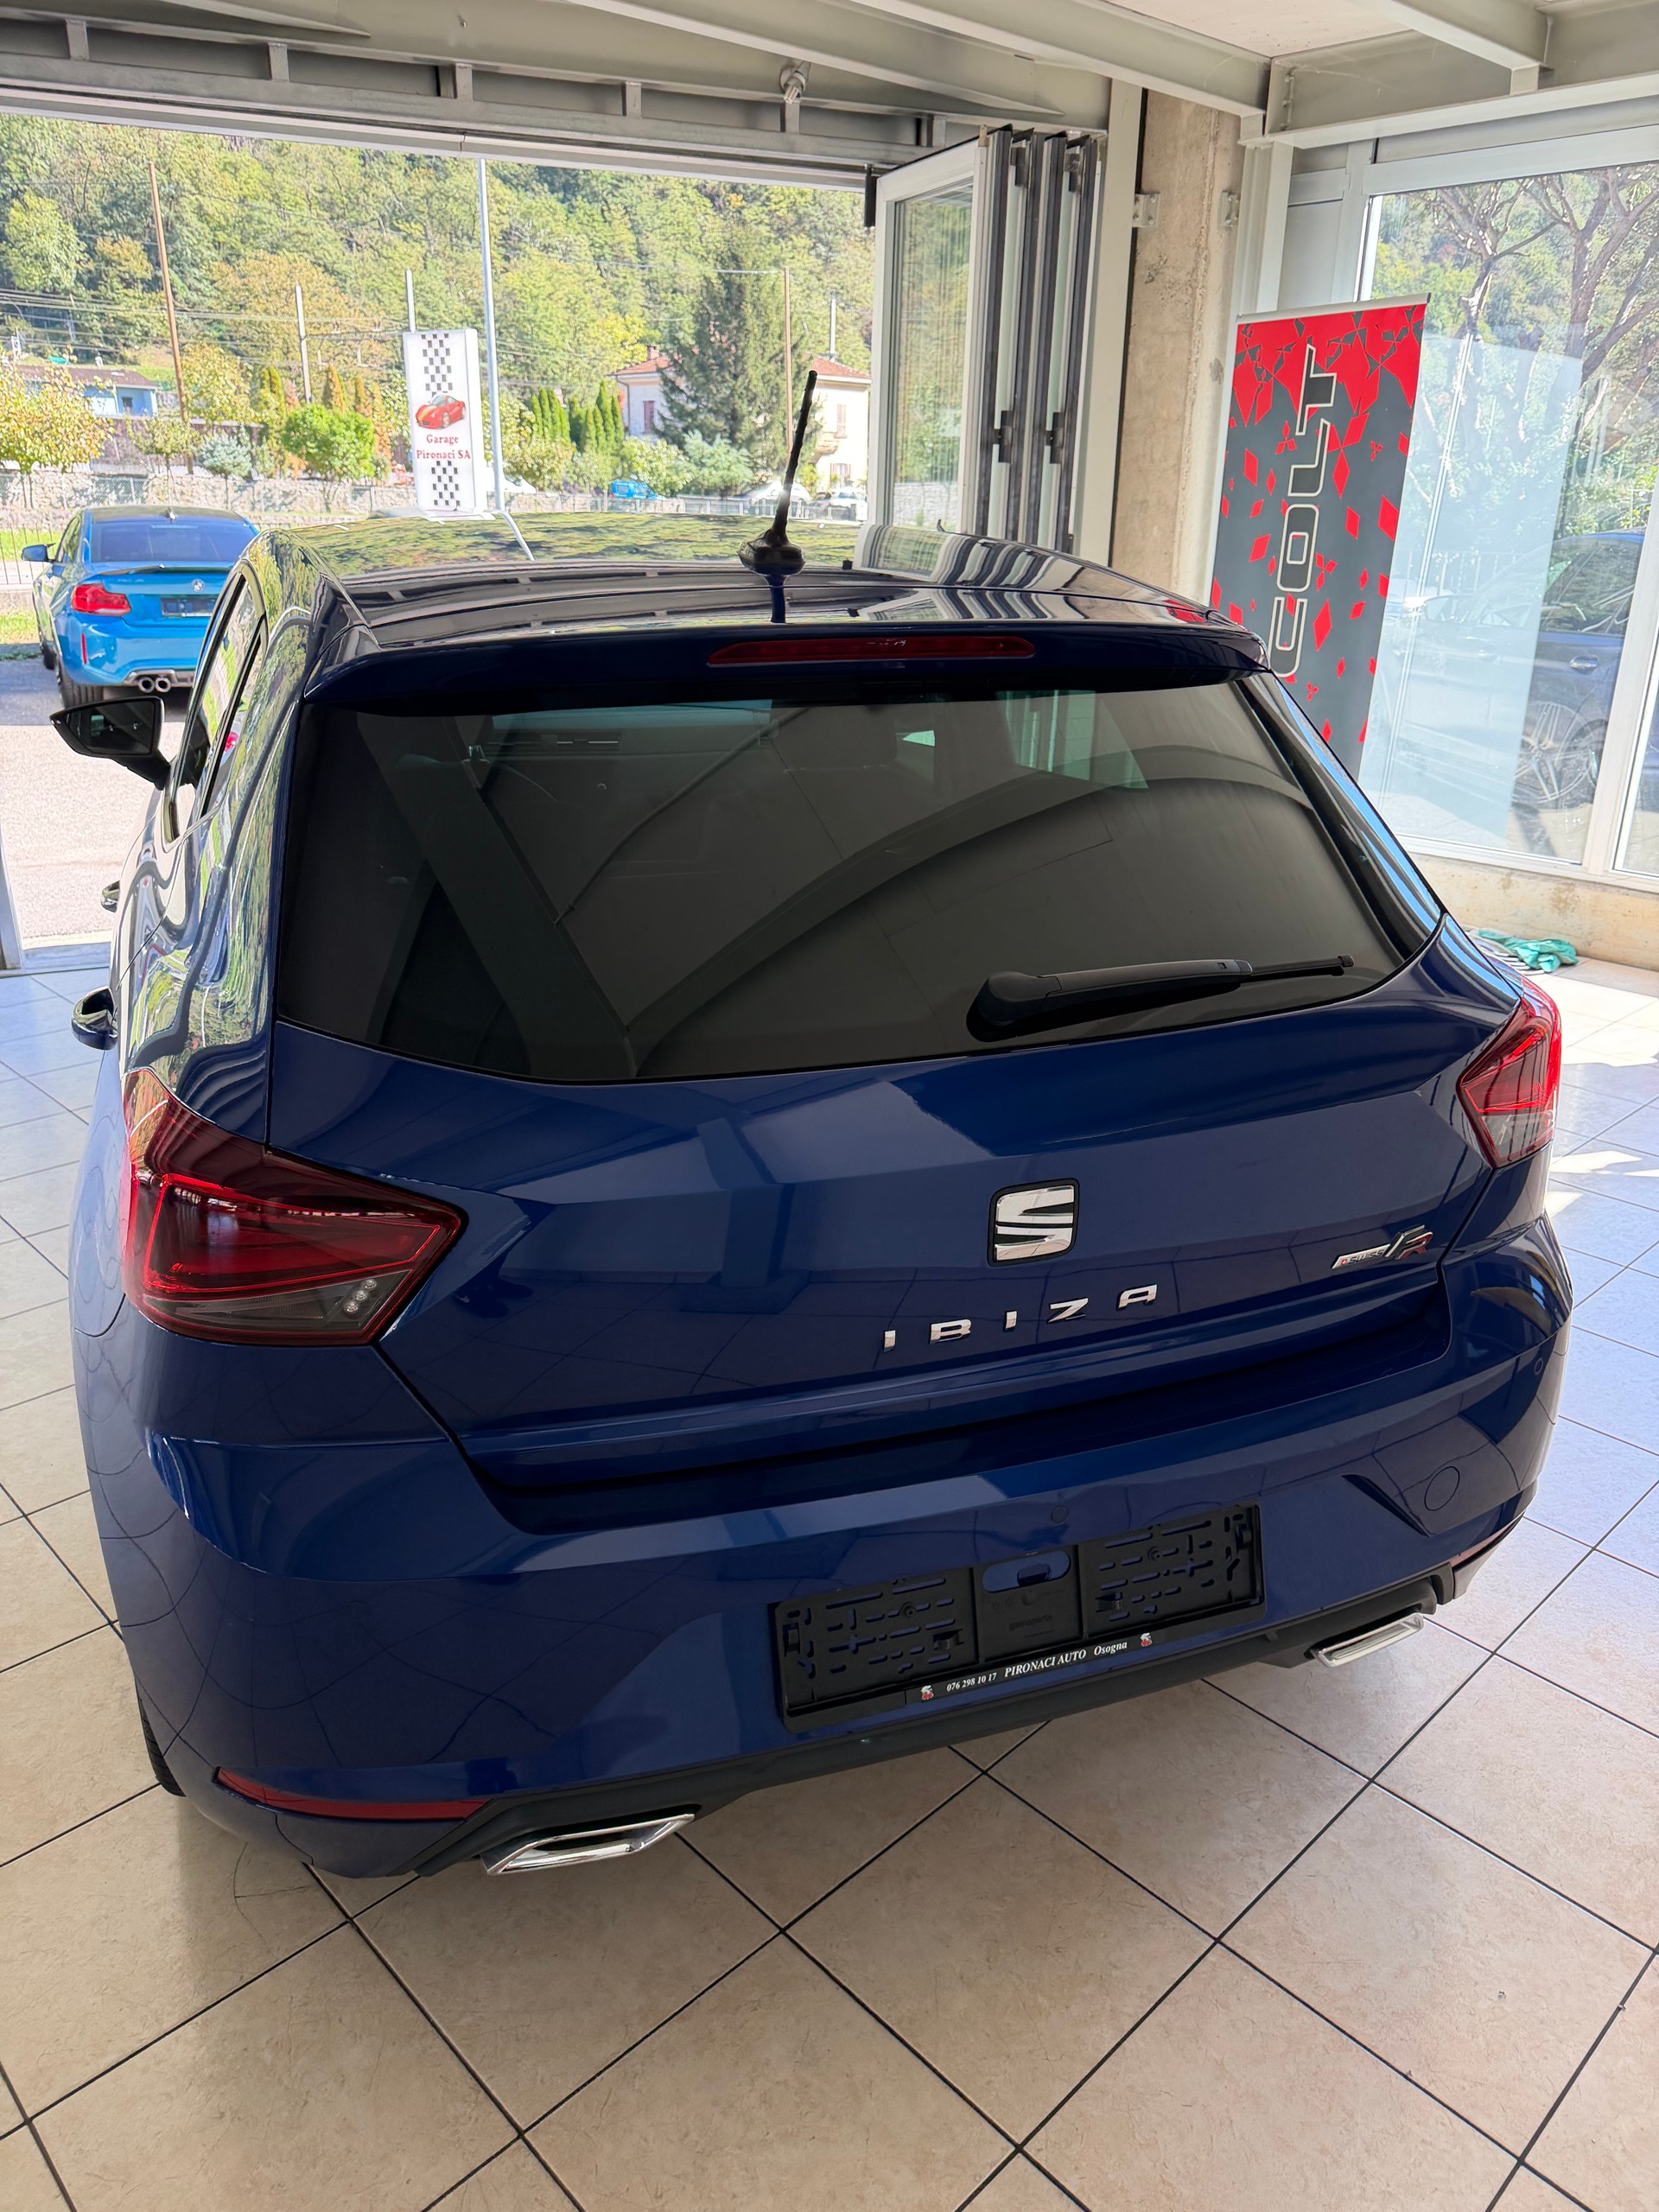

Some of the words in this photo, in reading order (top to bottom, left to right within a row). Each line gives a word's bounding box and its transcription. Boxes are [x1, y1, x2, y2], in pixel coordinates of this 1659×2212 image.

[416, 449, 455, 459] Pironaci
[458, 449, 471, 459] SA
[426, 434, 459, 446] Garage
[1268, 343, 1337, 677] COLT
[883, 1284, 1158, 1352] IBIZA
[946, 1681, 961, 1692] 076
[962, 1677, 976, 1688] 298
[977, 1675, 987, 1684] 10
[988, 1672, 997, 1681] 17
[1004, 1656, 1056, 1677] PIRONACI
[1057, 1649, 1087, 1665] AUTO
[1094, 1642, 1128, 1656] Osogna
